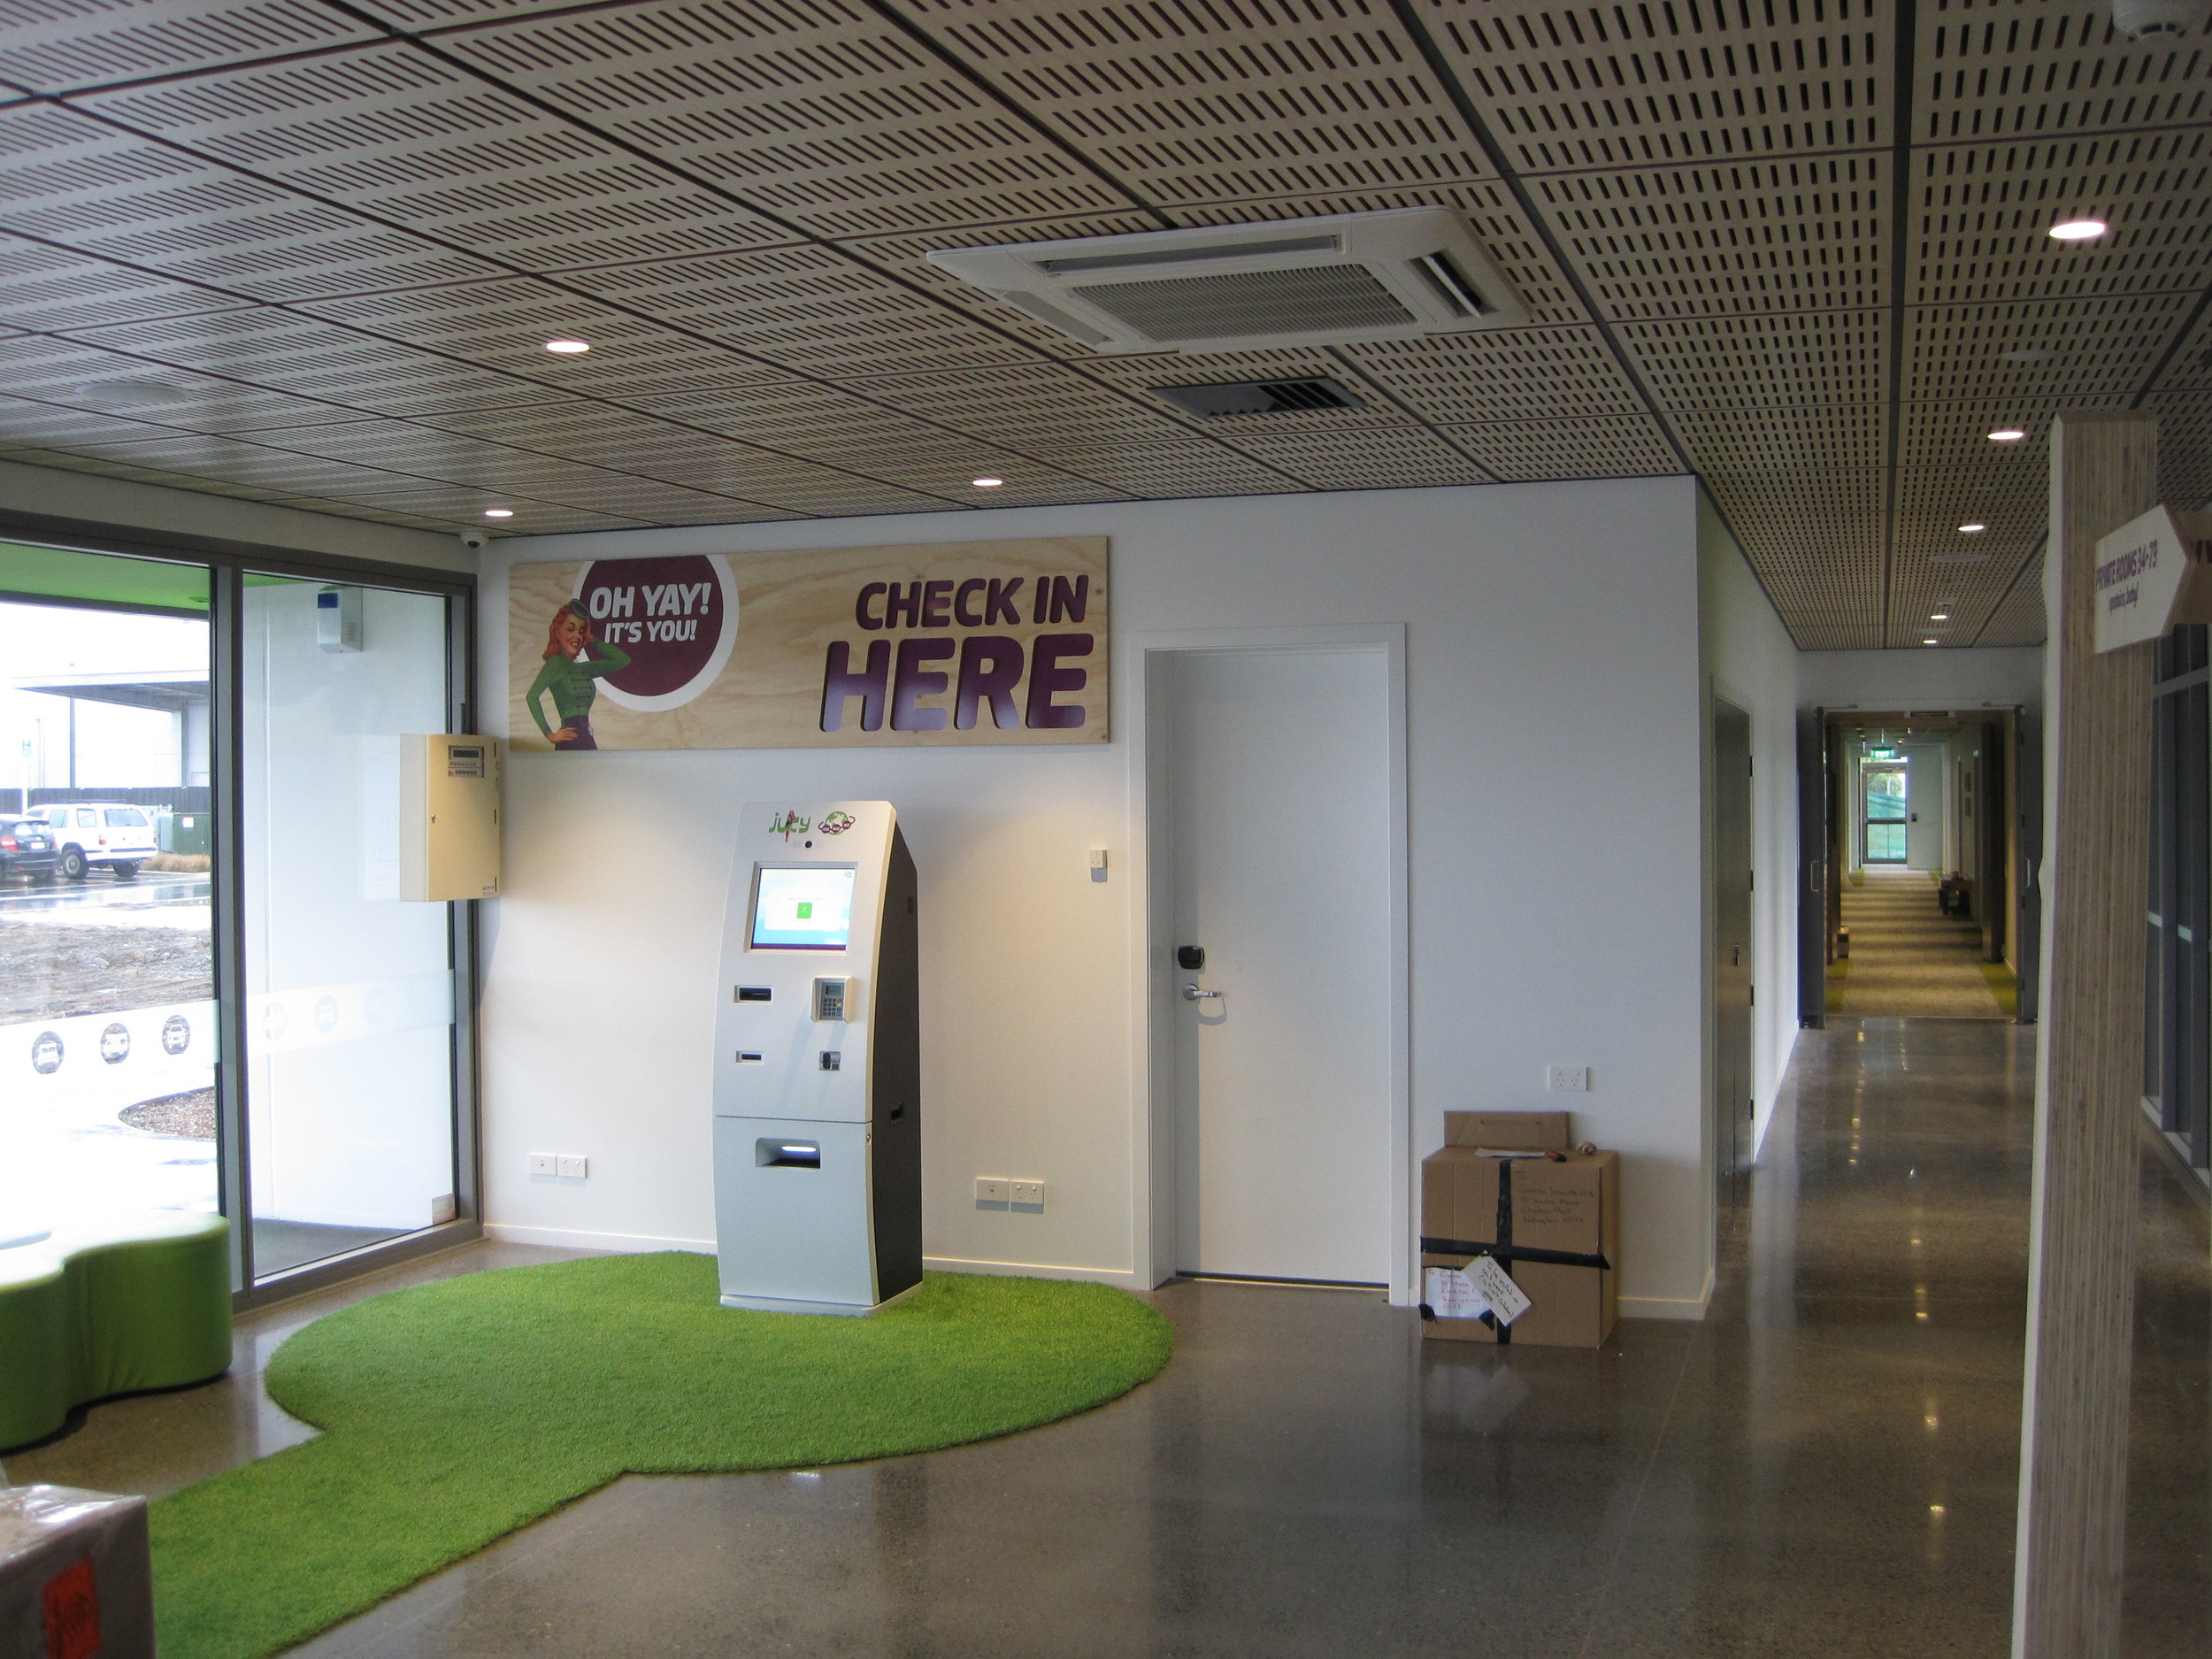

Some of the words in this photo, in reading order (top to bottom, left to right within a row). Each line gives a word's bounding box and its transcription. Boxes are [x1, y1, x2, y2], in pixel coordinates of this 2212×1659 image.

[589, 586, 634, 619] OH
[641, 582, 711, 617] YAY!
[856, 577, 1025, 631] CHECK
[1033, 575, 1089, 624] IN
[604, 621, 642, 643] IT'S
[647, 619, 697, 642] YOU!
[819, 633, 1094, 733] HERE
